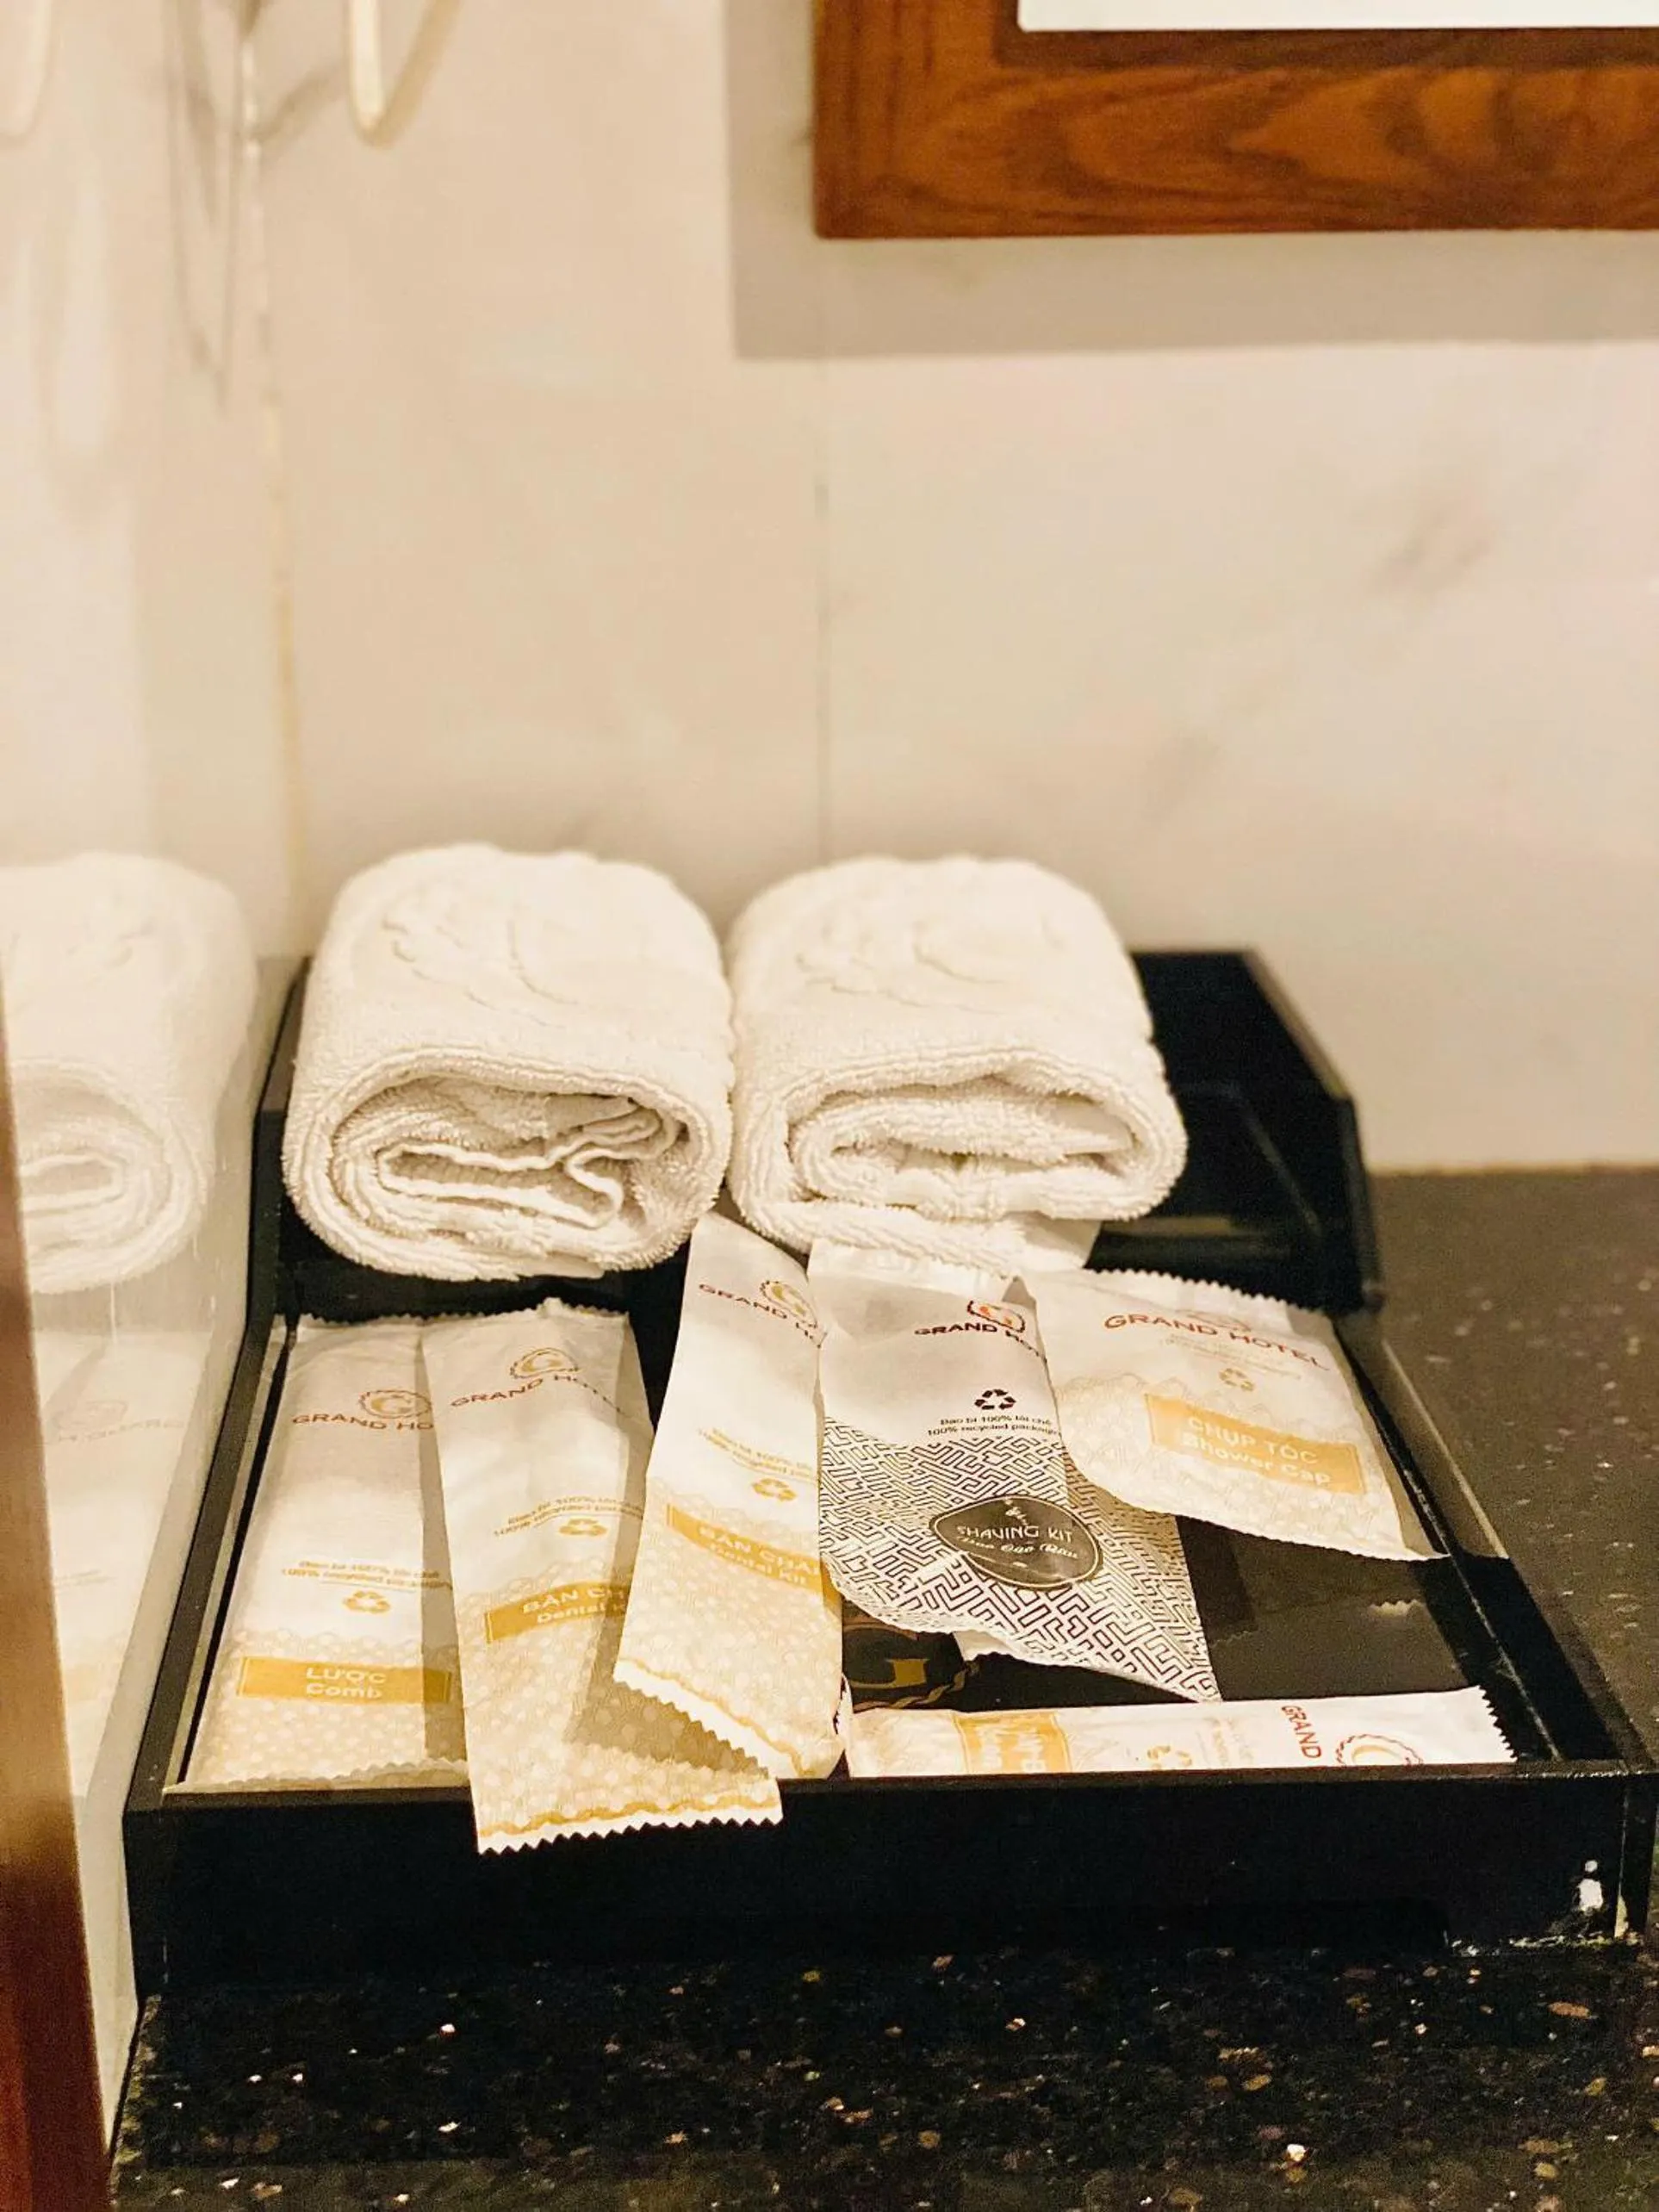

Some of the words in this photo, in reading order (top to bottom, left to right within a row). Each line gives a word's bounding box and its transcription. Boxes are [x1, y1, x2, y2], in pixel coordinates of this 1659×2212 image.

[699, 1283, 787, 1320] GRAND
[915, 1322, 997, 1335] GRAND
[1104, 1314, 1218, 1335] GRAND
[1229, 1331, 1330, 1371] HOTEL
[451, 1378, 544, 1407] GRAND
[293, 1414, 387, 1430] GRAND
[928, 1426, 958, 1436] 100%
[1182, 1431, 1274, 1471] Shower
[1281, 1463, 1332, 1487] Cap
[956, 1525, 1040, 1540] SHAVING
[1048, 1526, 1074, 1544] KIT
[537, 1601, 606, 1624] Dental
[306, 1682, 383, 1699] Comb
[1281, 1705, 1322, 1760] GRAND
